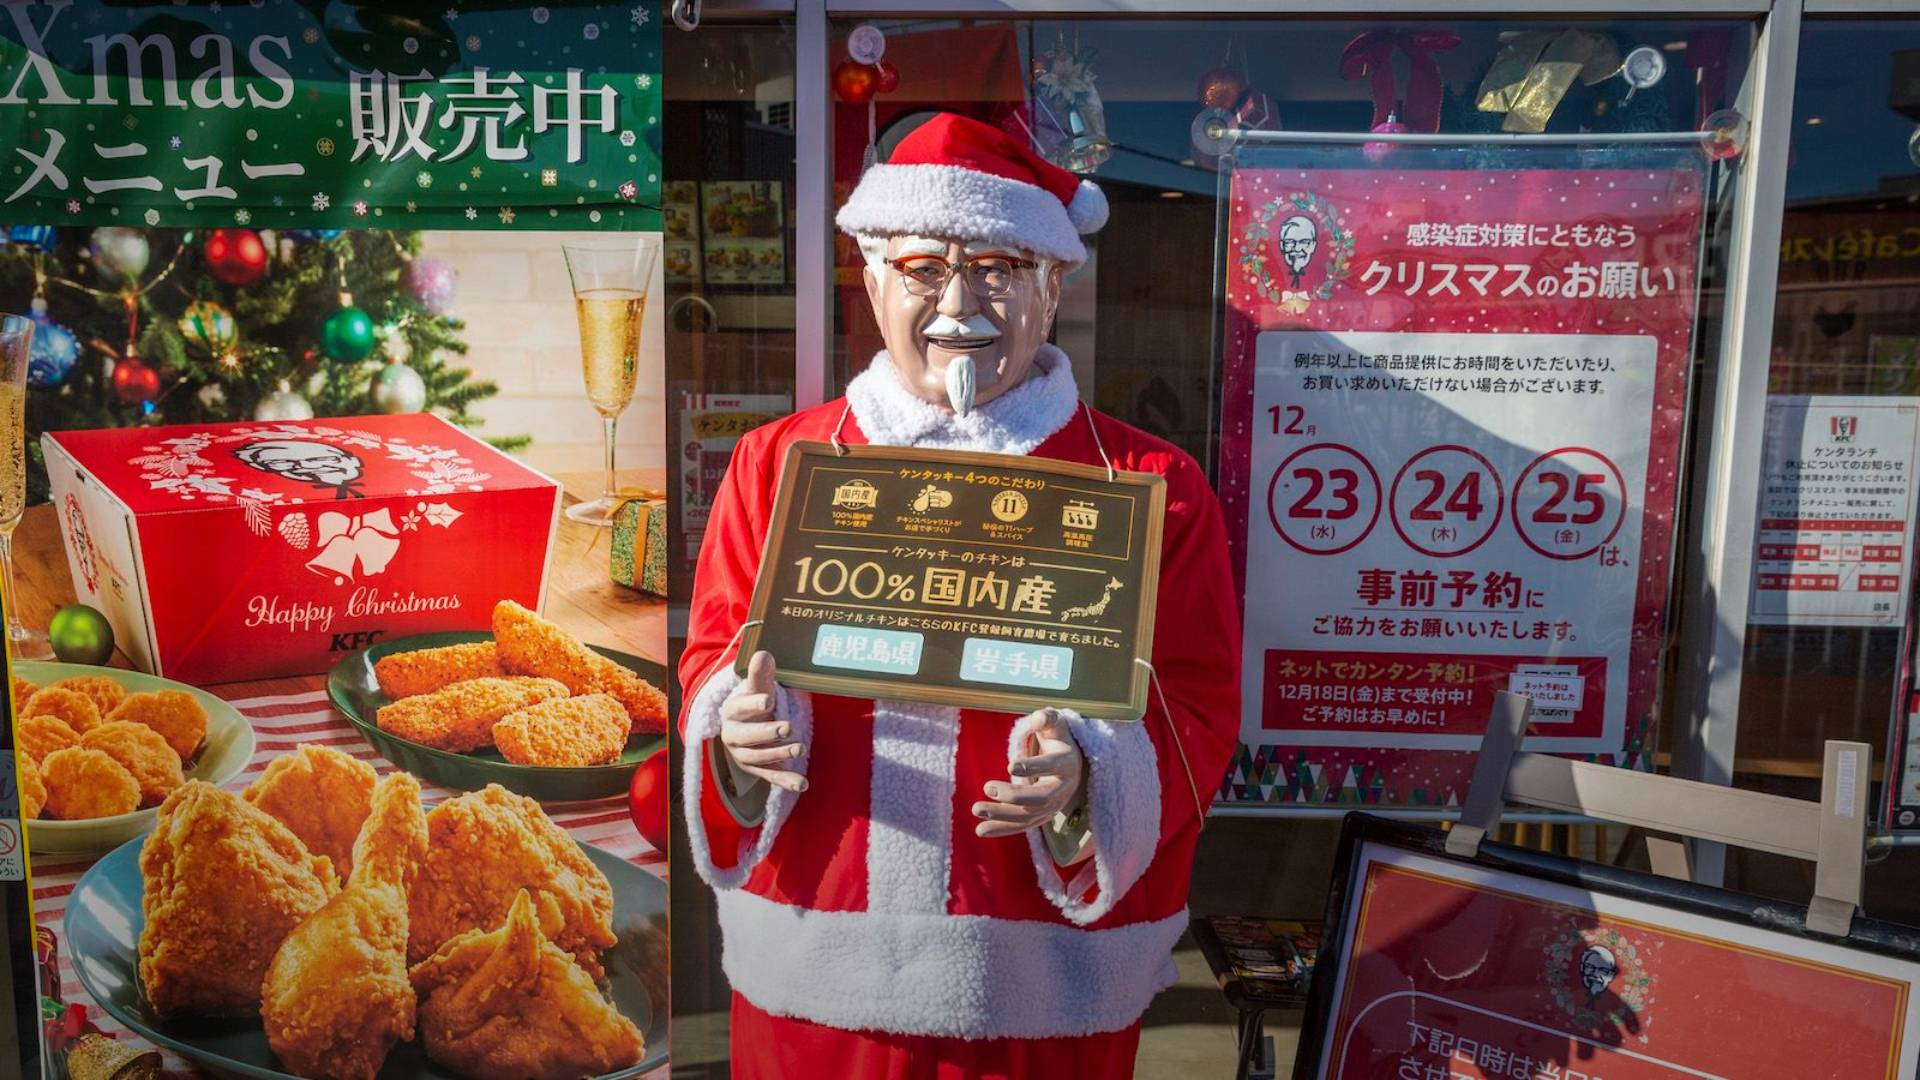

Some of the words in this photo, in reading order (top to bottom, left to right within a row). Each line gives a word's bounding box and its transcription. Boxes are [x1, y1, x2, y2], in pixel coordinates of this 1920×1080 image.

[2, 0, 295, 108] Xmas
[349, 66, 620, 164] 販売中
[7, 128, 306, 202] メニュー
[1407, 223, 1635, 248] 感染症対策にともなう
[1360, 260, 1676, 299] クリスマスのお願い
[1294, 352, 1617, 373] 例年以上に商品提供にお時間をいただいたり、
[1303, 375, 1606, 394] お買い求めいただけない場合がございます。
[1267, 405, 1317, 436] 12月
[1785, 460, 1904, 471] 休止についてのお知らせ
[1814, 448, 1878, 458] ケンタランチ
[899, 467, 1046, 491] ケンタッキー4つのこだわり
[841, 488, 871, 501] 国内産
[1002, 498, 1017, 514] 11
[1287, 468, 1360, 520] 23
[1409, 470, 1484, 522] 24
[1532, 472, 1606, 525] 25
[1310, 525, 1337, 541] (水)
[1431, 526, 1457, 542] (木)
[1554, 528, 1581, 545] (金)
[892, 546, 1026, 567] ケンタッキーのチキンは
[1600, 544, 1630, 567] は、
[794, 556, 1057, 616] 100%国内産
[1357, 569, 1545, 609] 事前予約に
[245, 594, 336, 633] Happy
[346, 586, 462, 619] Christmas
[328, 630, 385, 652] KFC
[1312, 615, 1578, 643] ご協力をお願いいたします。
[816, 633, 917, 667] 鹿児島県
[972, 647, 1062, 681] 岩手県
[1406, 1020, 1602, 1080] 下記日時は当
